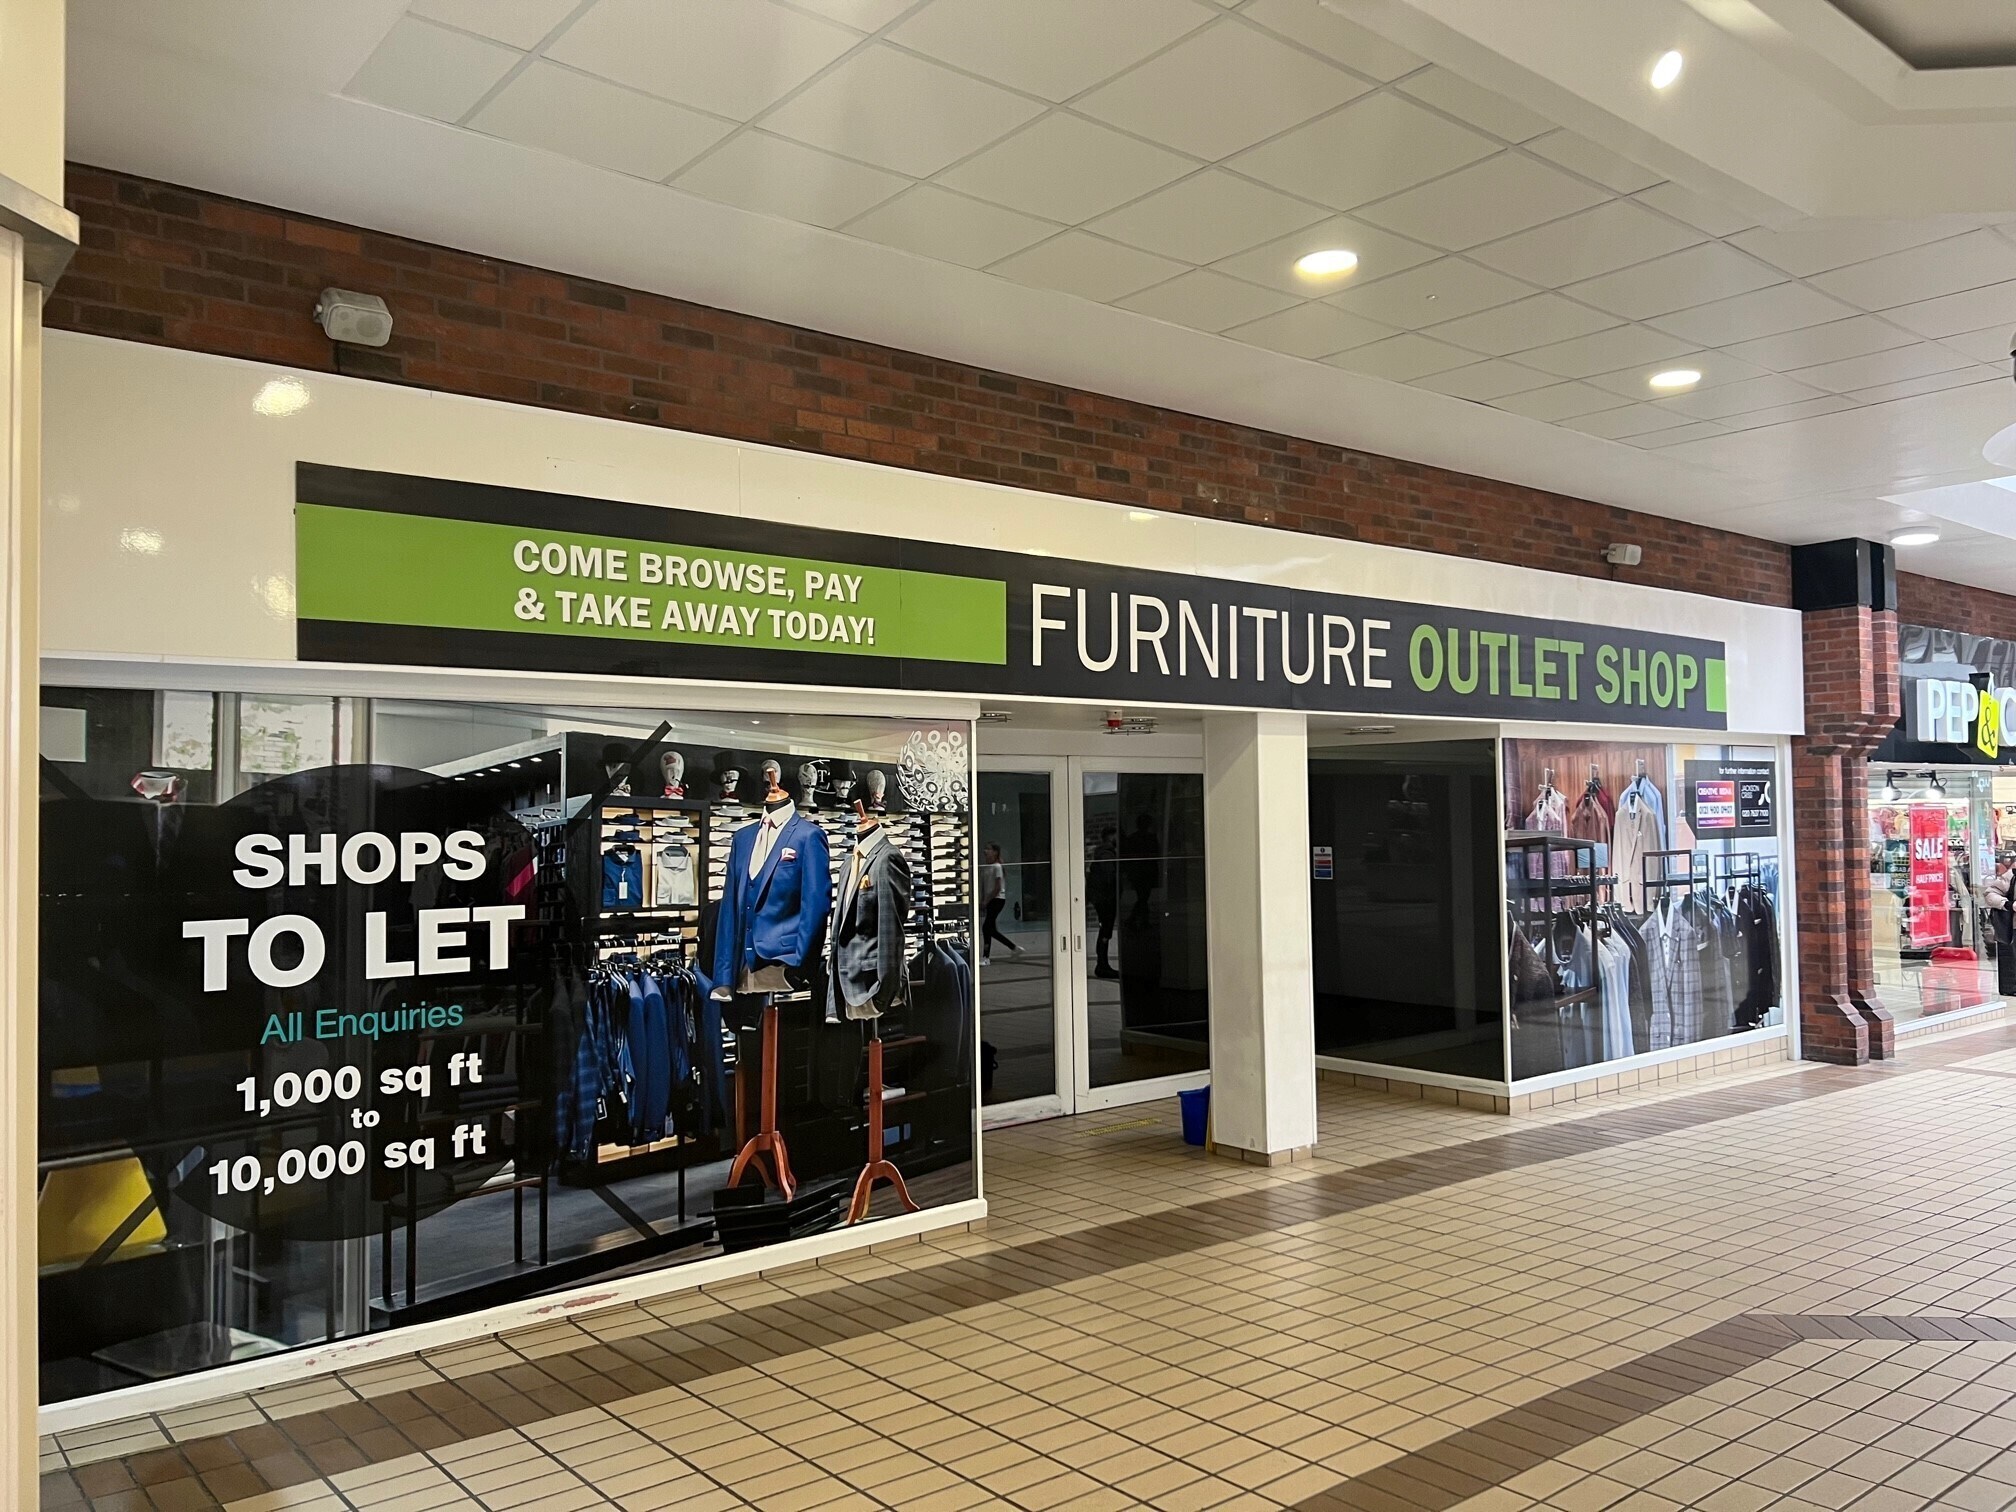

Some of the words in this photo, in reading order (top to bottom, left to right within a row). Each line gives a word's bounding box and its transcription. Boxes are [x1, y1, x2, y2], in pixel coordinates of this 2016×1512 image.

[513, 540, 627, 581] COME
[640, 552, 795, 602] BROWSE,
[805, 570, 862, 603] PAY
[513, 587, 545, 621] &
[555, 591, 651, 628] TAKE
[661, 600, 760, 636] AWAY
[767, 609, 874, 645] TODAY!
[1032, 583, 1392, 688] FURNITURE
[1409, 624, 1584, 700] OUTLET
[1595, 644, 1698, 708] SHOP
[232, 830, 487, 888] SHOPS
[1915, 838, 1943, 859] SALE
[182, 914, 326, 992] TO
[365, 904, 526, 979] LET
[260, 1012, 302, 1045] All
[316, 1001, 463, 1040] Enquiries
[236, 1065, 362, 1118] 1,000
[380, 1064, 431, 1097] sq
[448, 1053, 483, 1086] ft
[351, 1108, 380, 1129] to
[208, 1140, 366, 1196] 10,000
[384, 1137, 435, 1170] sq
[451, 1124, 486, 1158] ft
